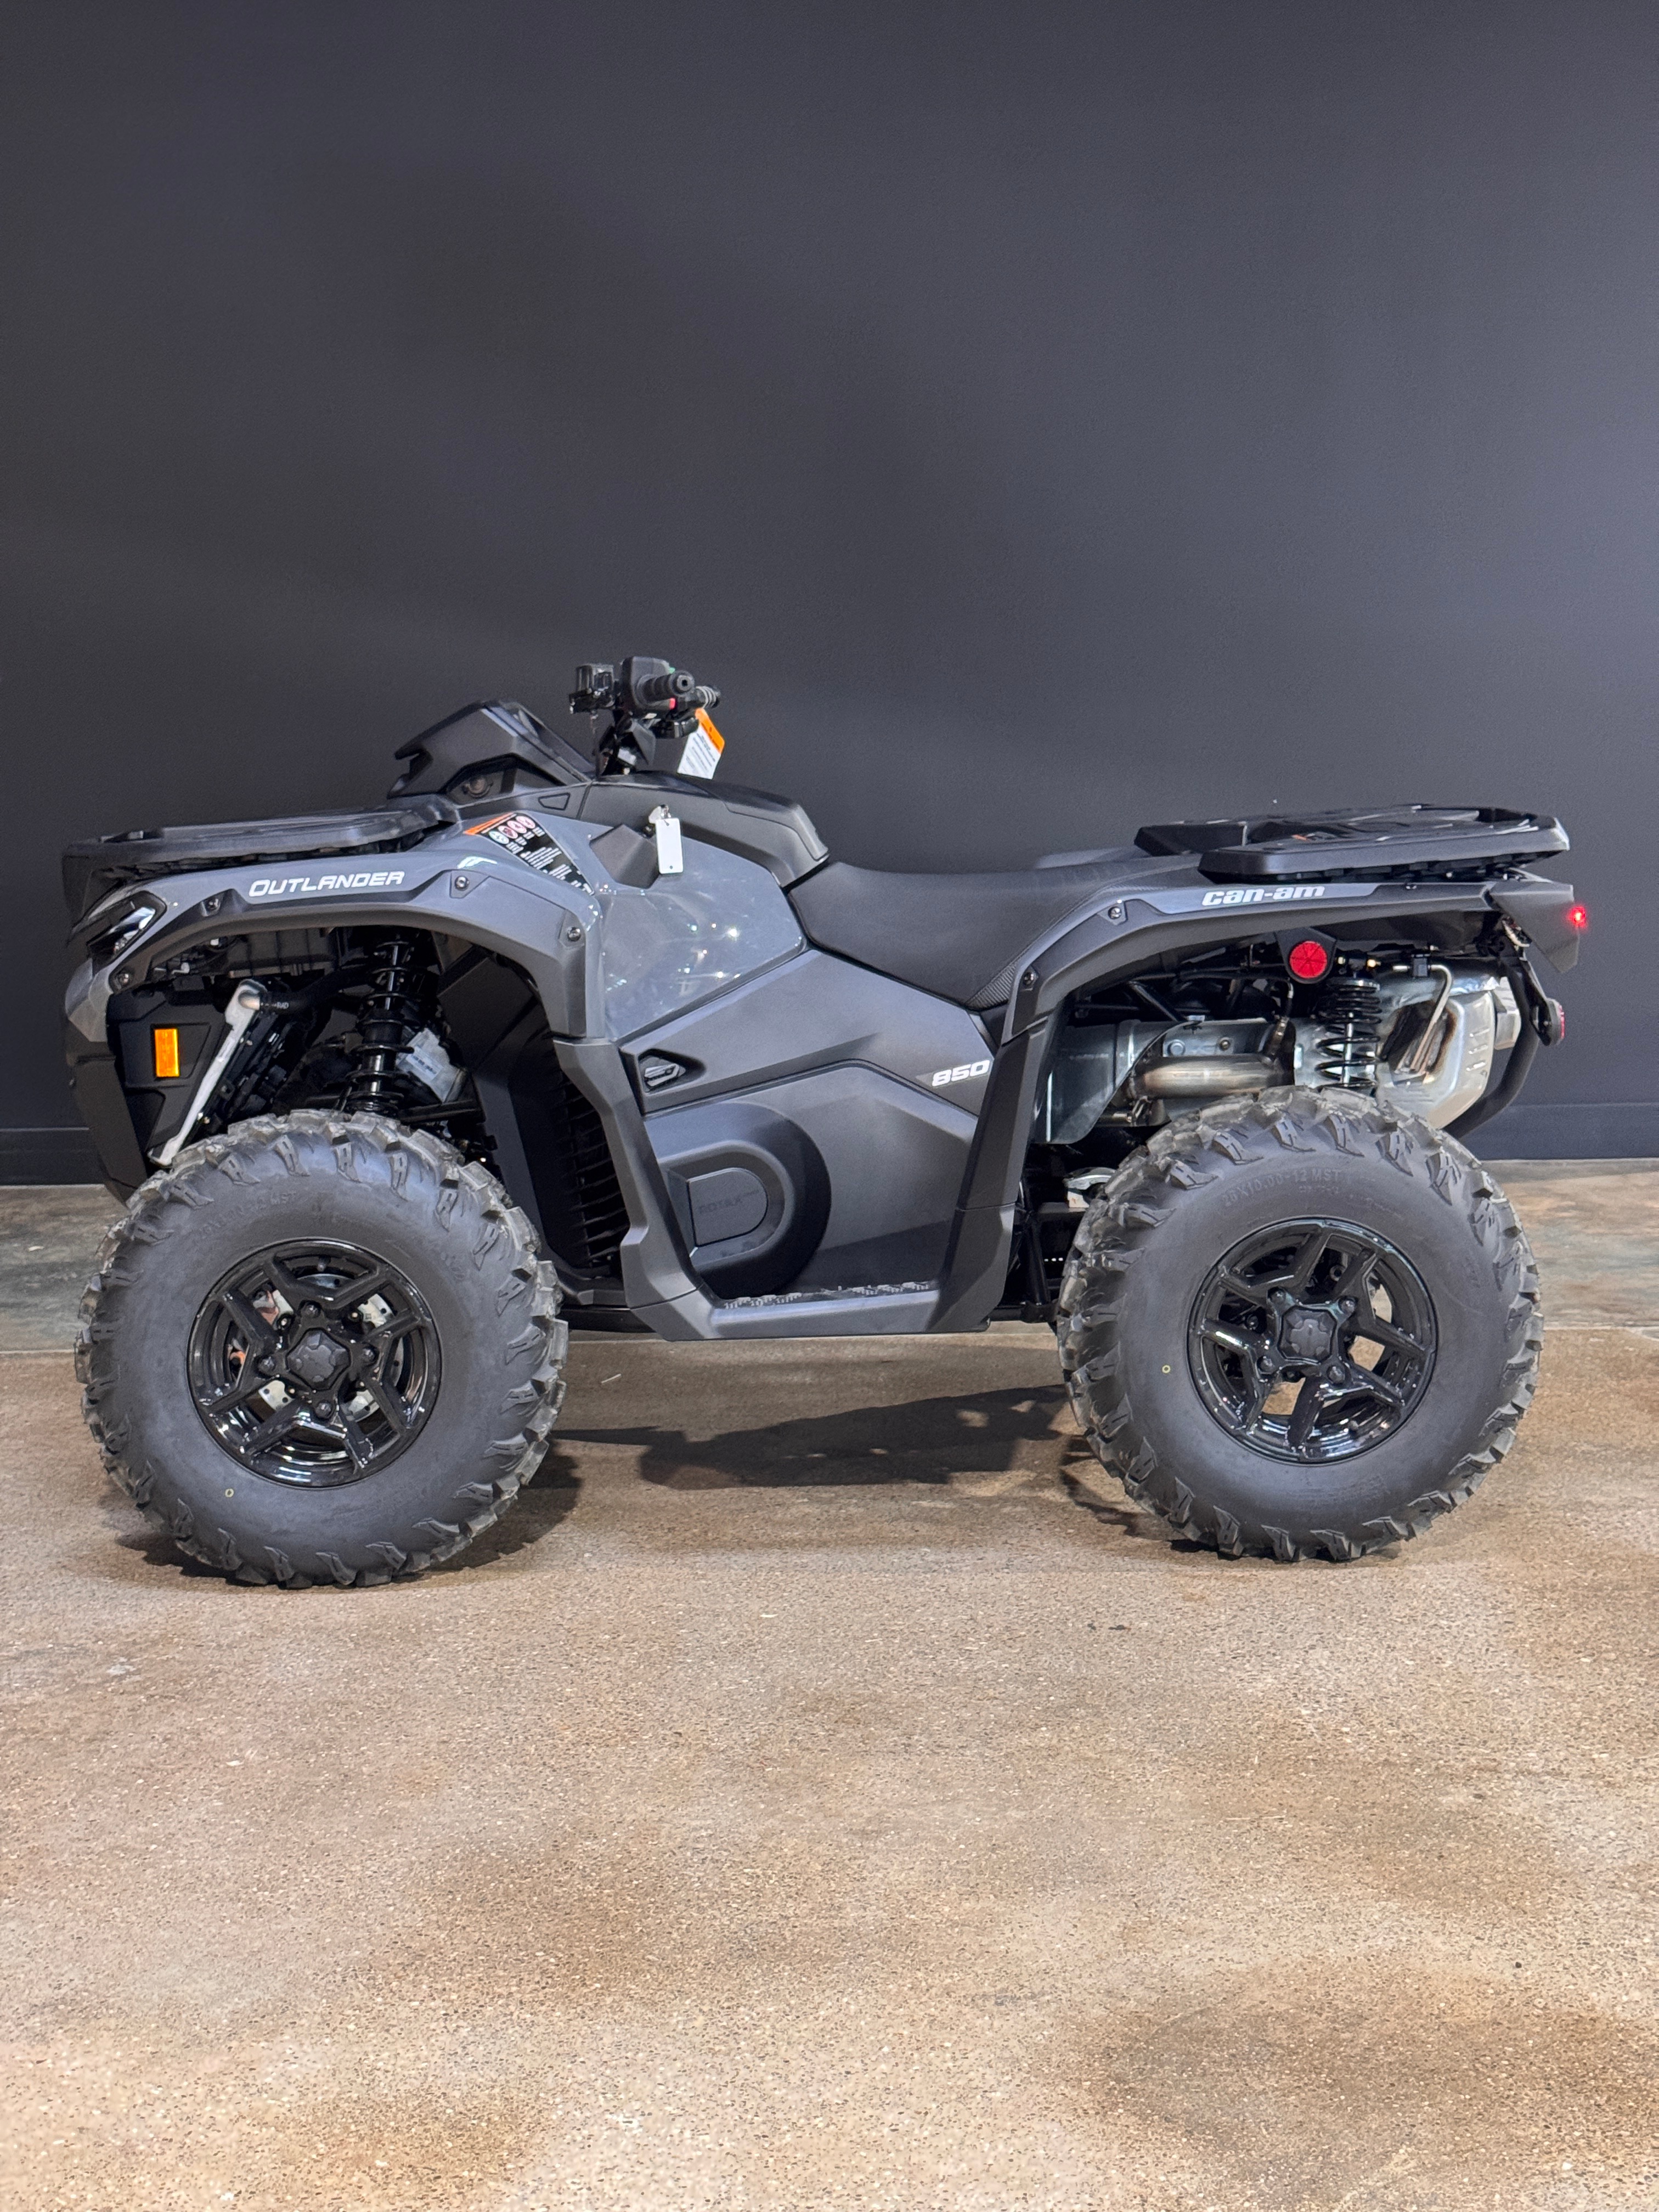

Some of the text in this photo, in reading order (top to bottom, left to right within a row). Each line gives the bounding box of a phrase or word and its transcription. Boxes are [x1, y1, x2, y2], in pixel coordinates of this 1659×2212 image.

[249, 871, 405, 897] OUTLANDER
[1202, 885, 1325, 906] can-am
[932, 1059, 990, 1086] 850
[1312, 1167, 1342, 1182] MST
